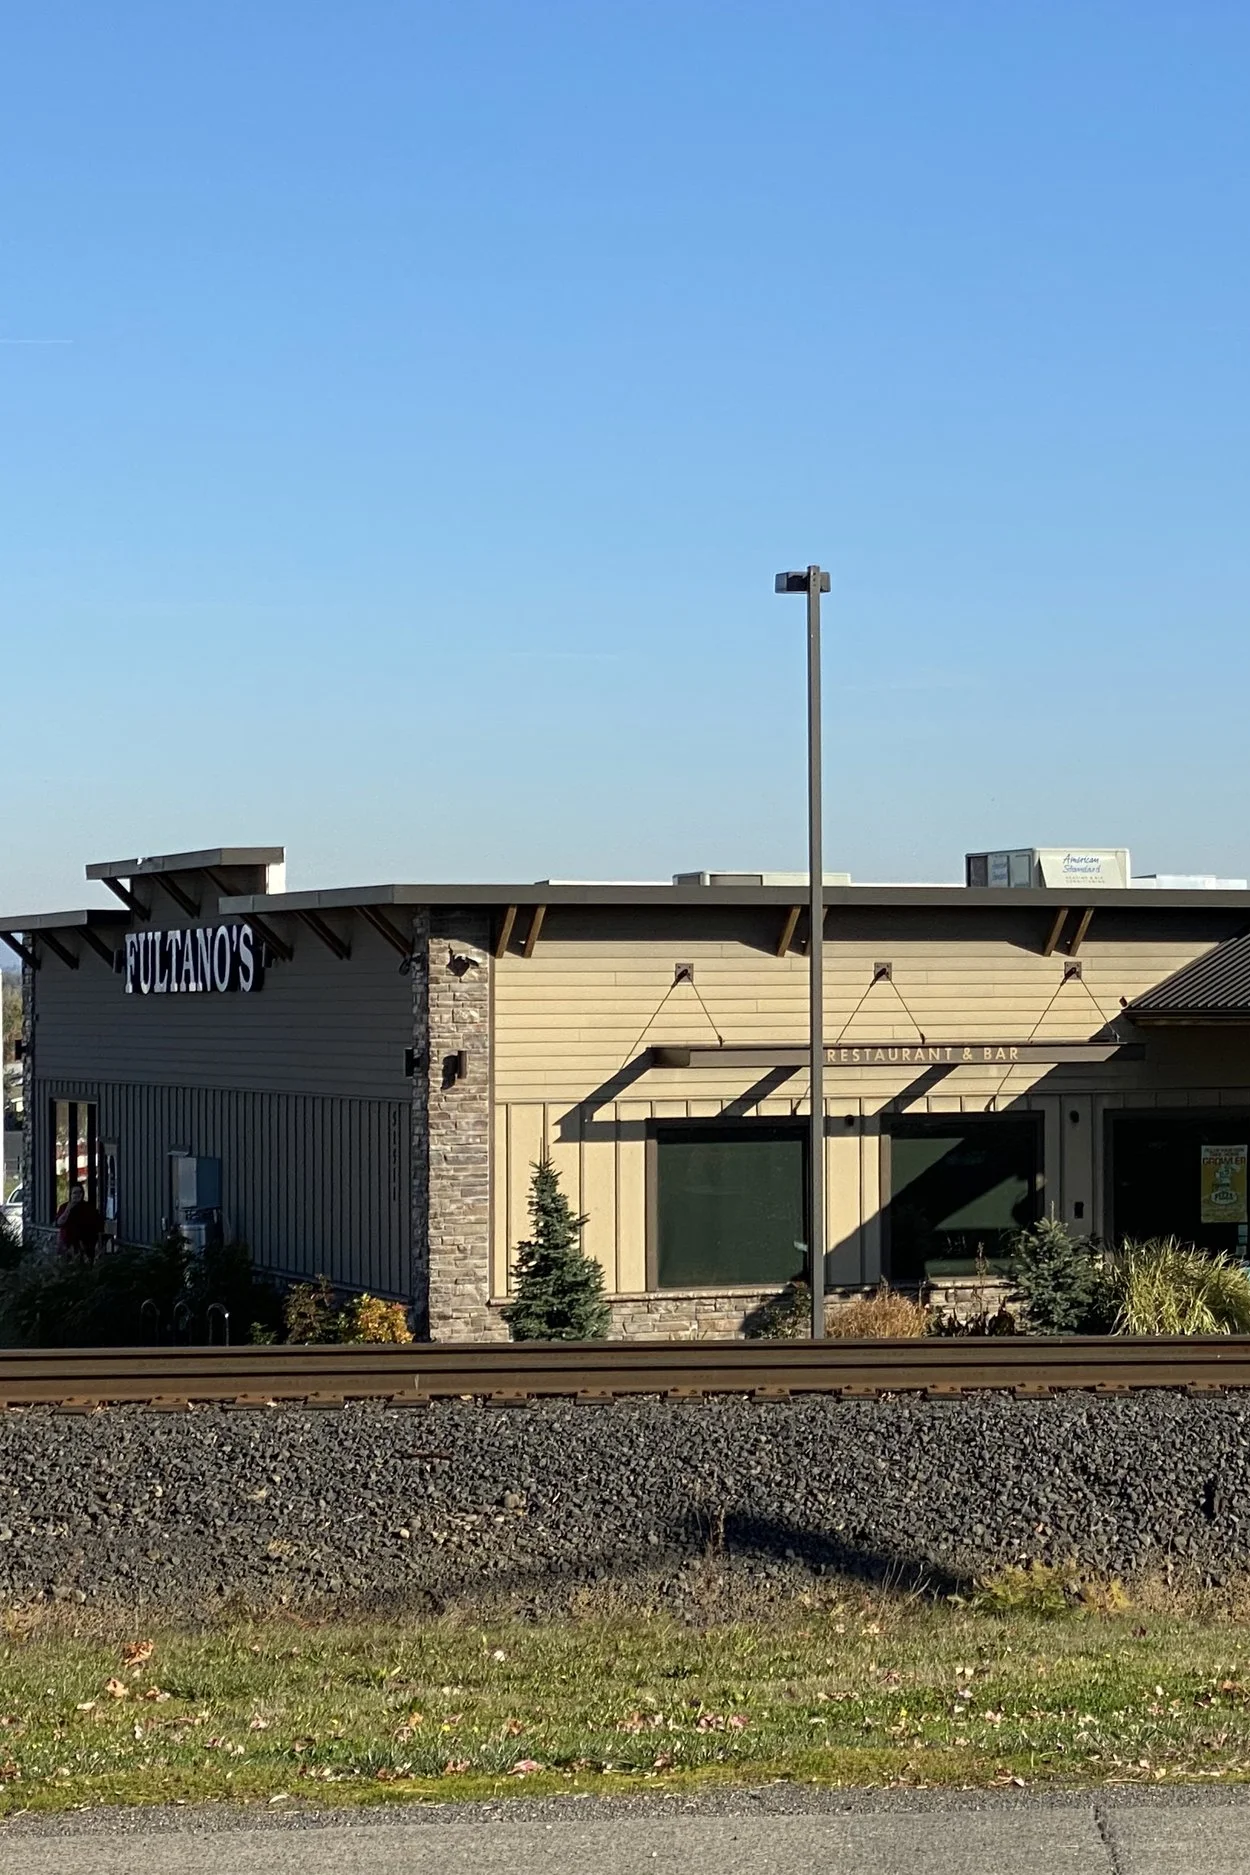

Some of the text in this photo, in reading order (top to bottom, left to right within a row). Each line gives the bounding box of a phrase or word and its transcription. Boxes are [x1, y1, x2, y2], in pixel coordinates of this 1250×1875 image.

[1062, 853, 1099, 864] American
[1062, 864, 1101, 873] Standard
[124, 923, 255, 995] FULTANO'S
[827, 1046, 1019, 1062] RESTAURANT & BAR
